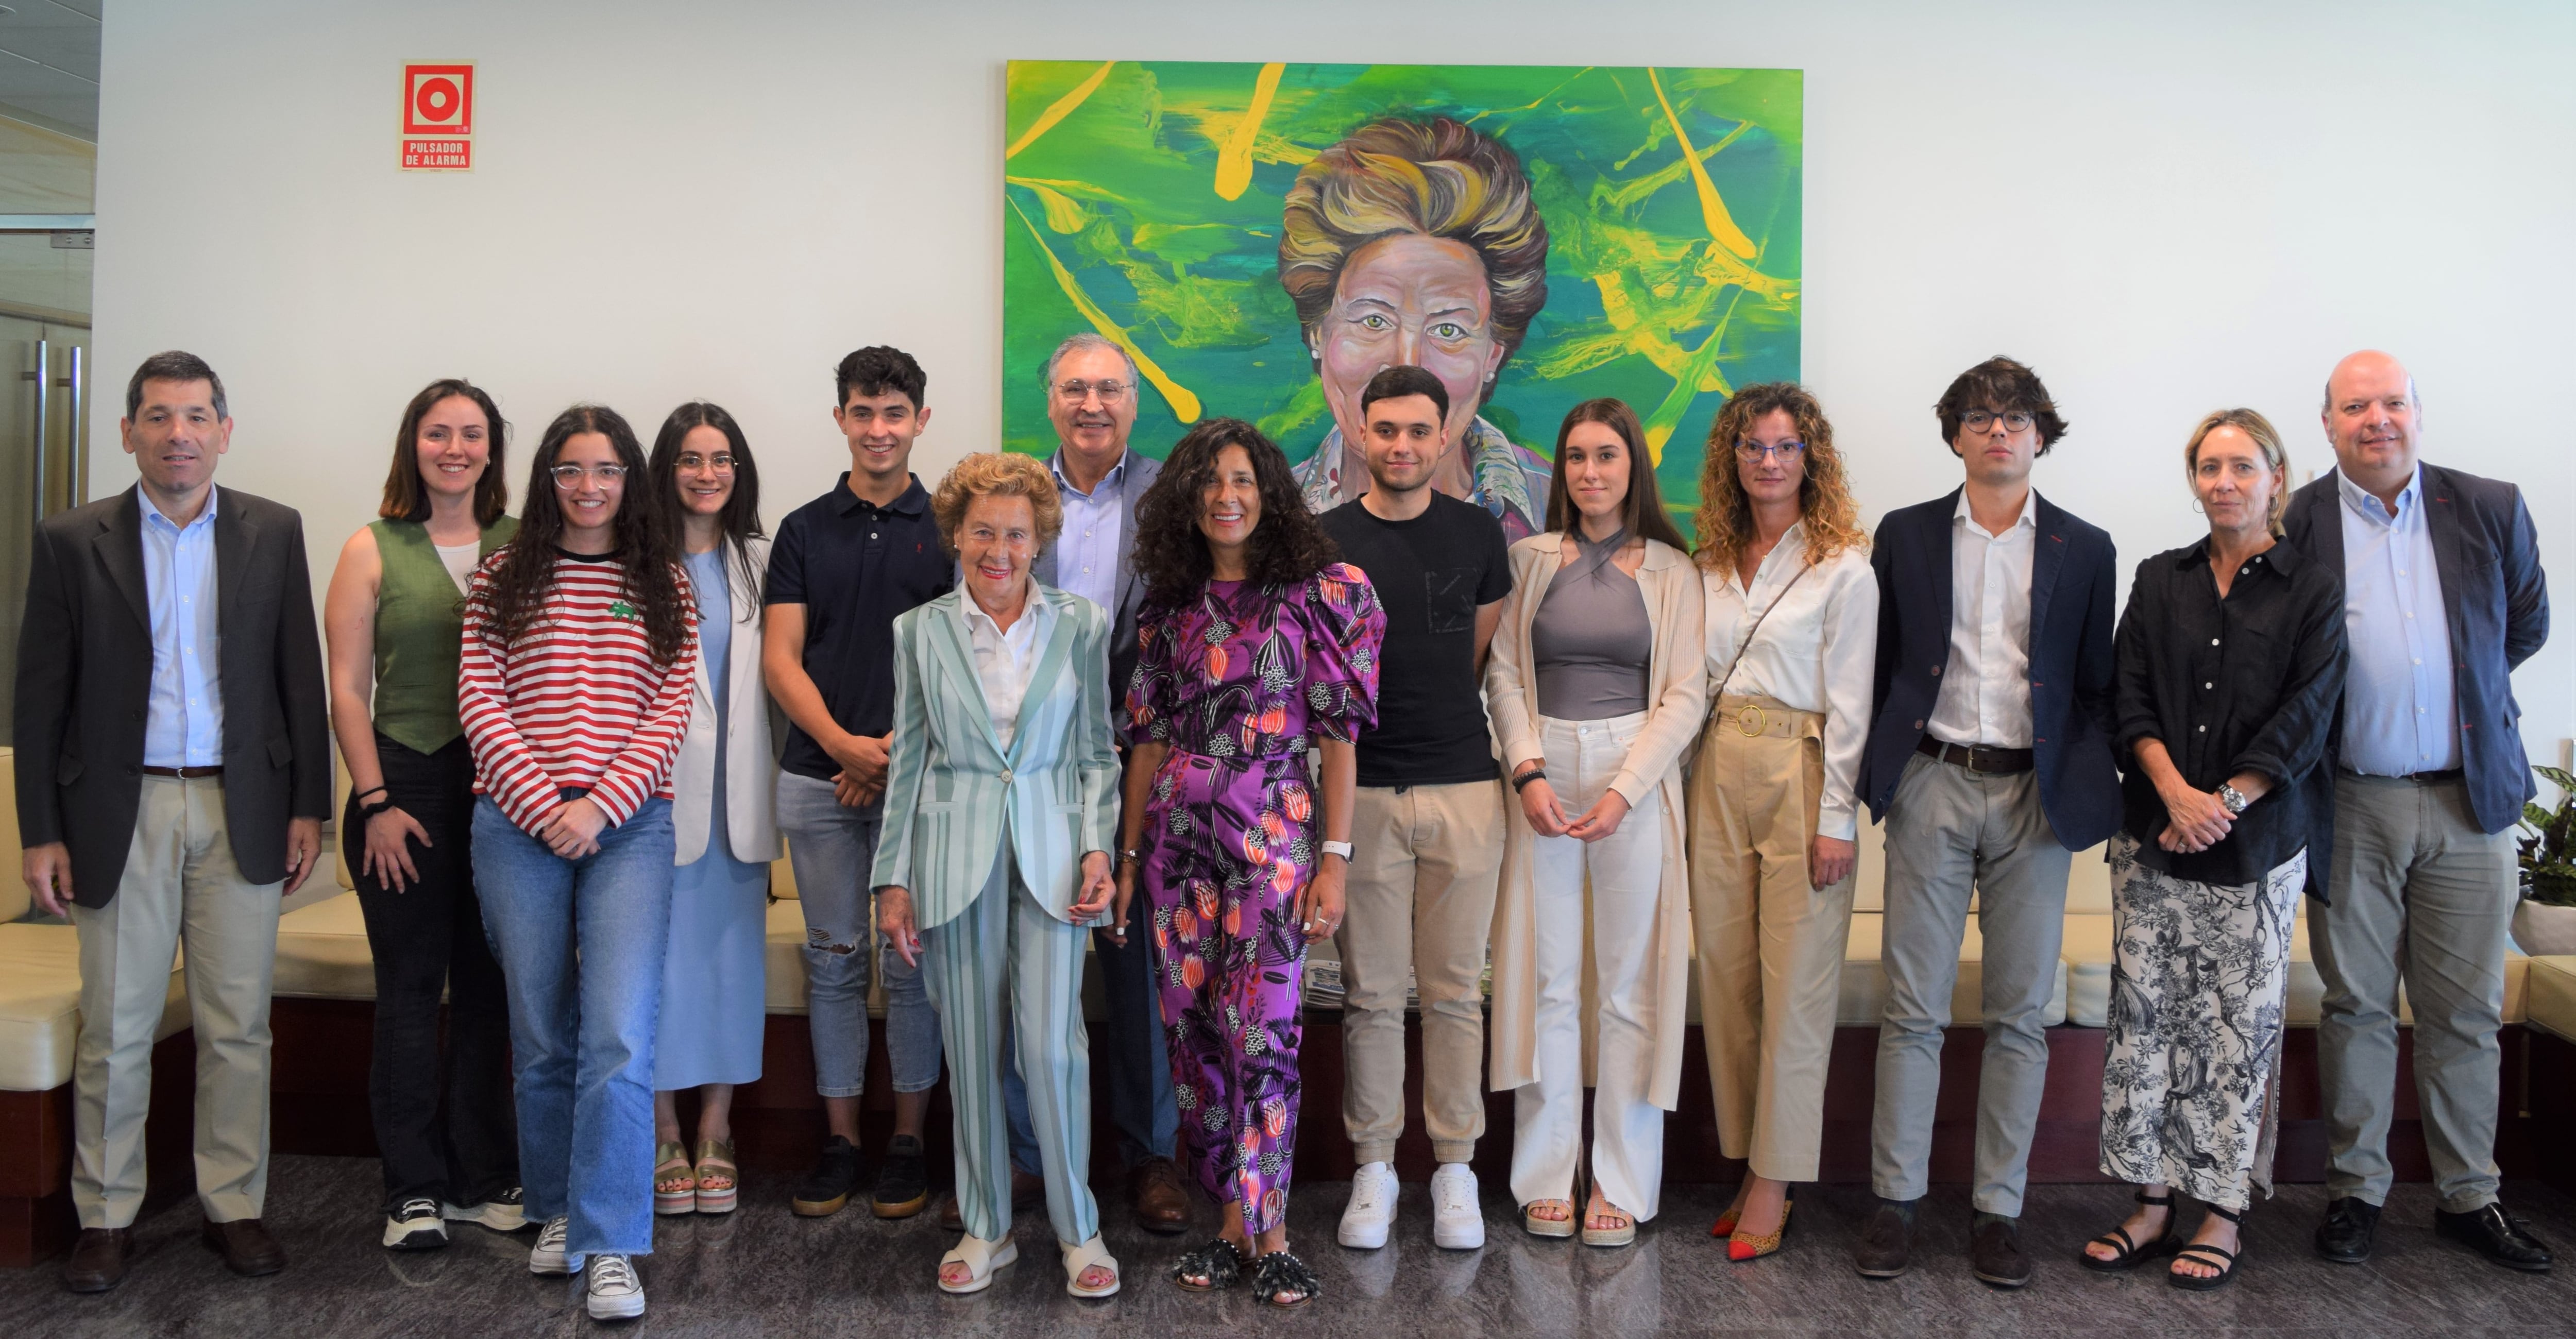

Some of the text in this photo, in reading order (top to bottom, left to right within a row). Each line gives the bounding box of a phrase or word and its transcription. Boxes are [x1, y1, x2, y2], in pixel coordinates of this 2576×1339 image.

[410, 143, 463, 153] PULSADOR
[406, 155, 466, 165] DE ALARMA
